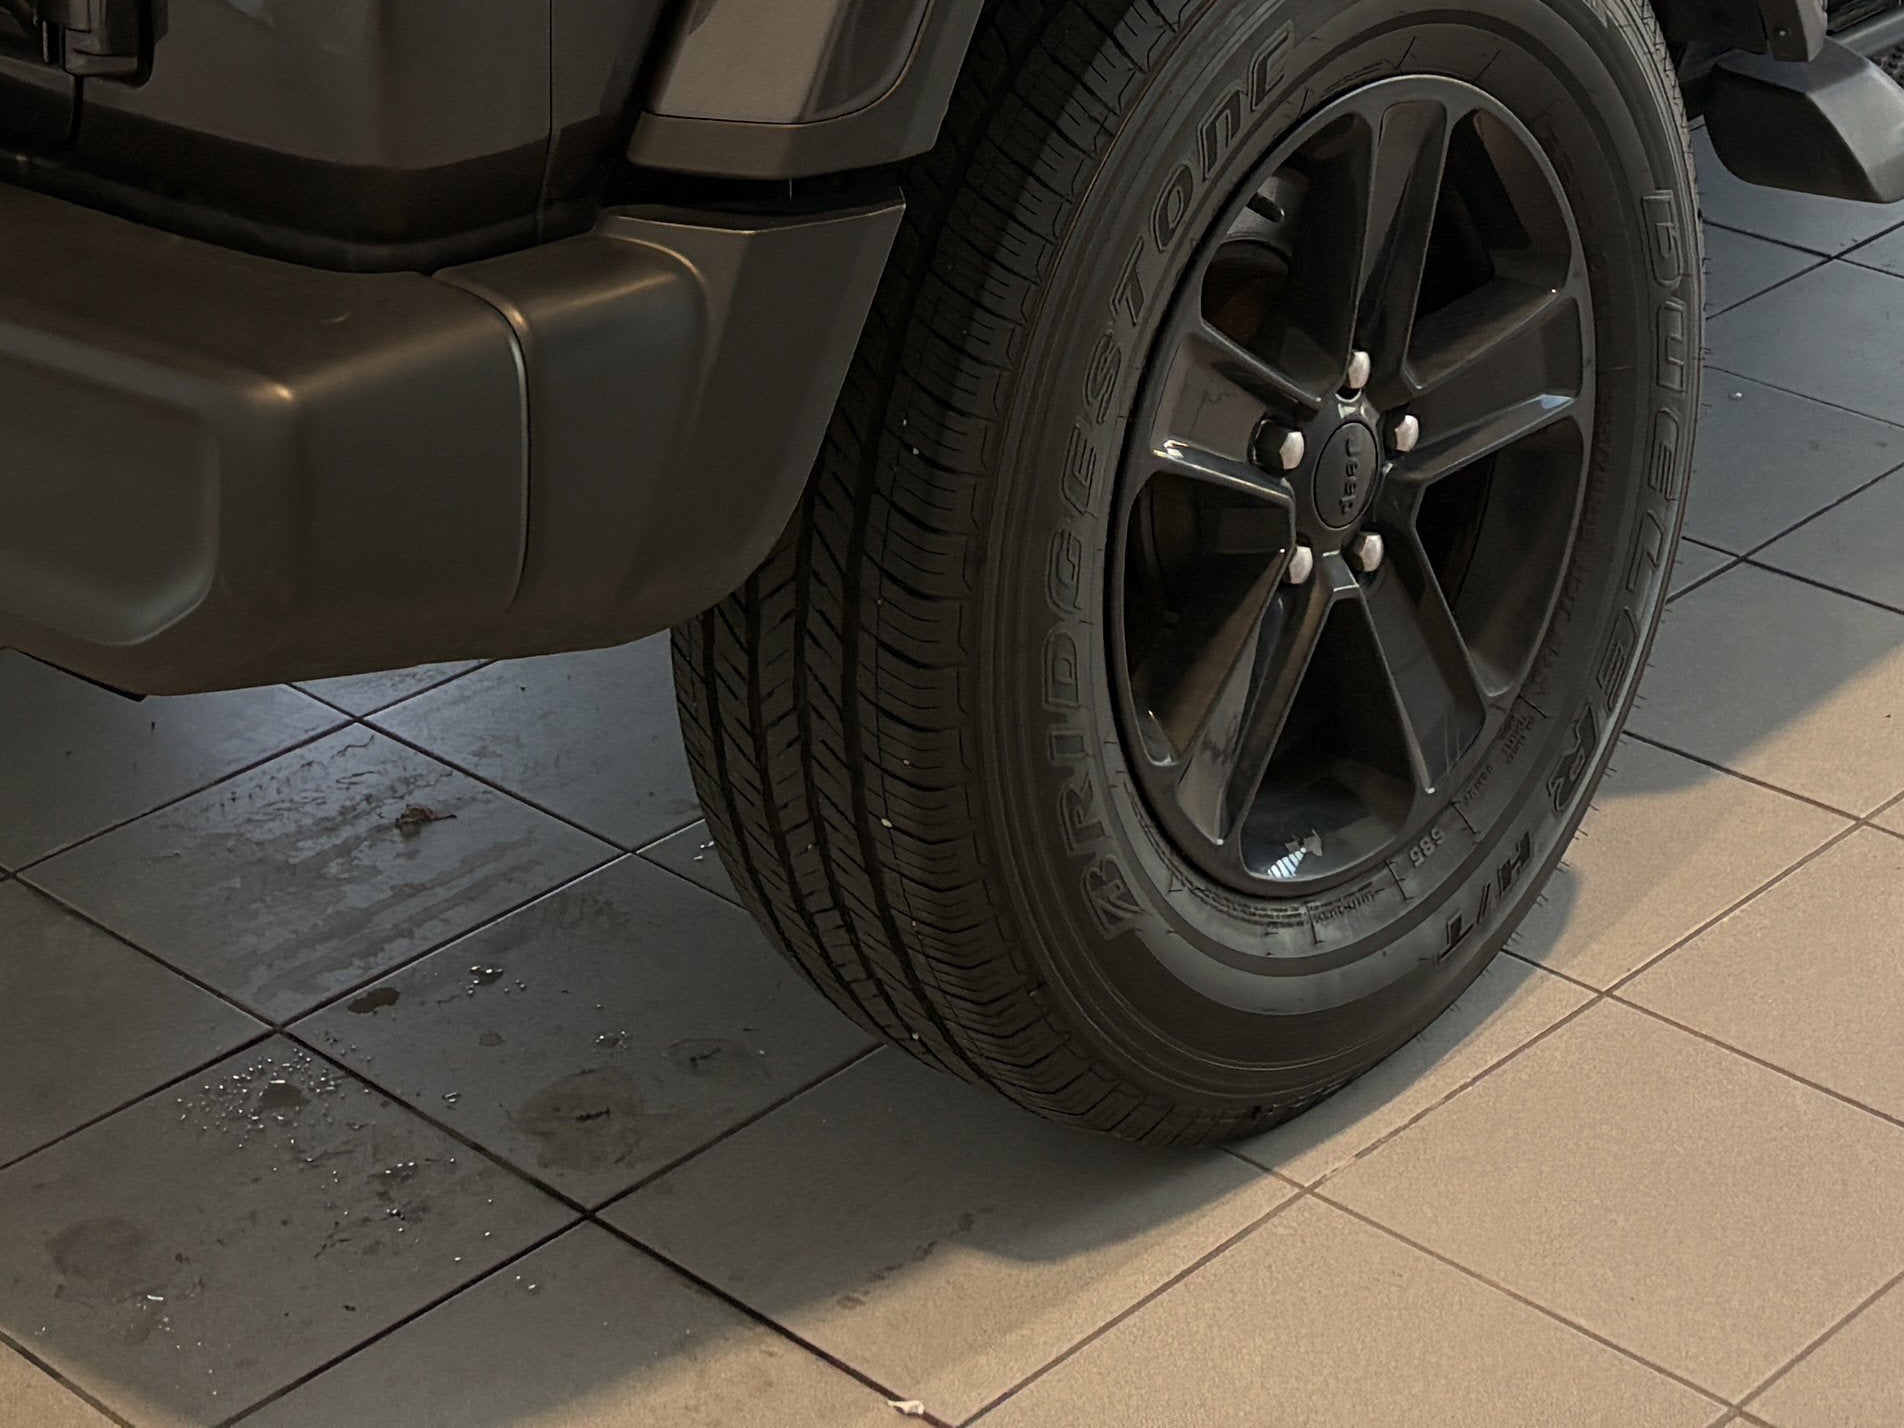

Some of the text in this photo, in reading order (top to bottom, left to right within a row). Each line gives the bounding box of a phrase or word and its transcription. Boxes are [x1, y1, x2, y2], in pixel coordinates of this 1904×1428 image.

[1040, 18, 1296, 941] BRIDGESTONE
[1545, 188, 1685, 815] DUELER
[1437, 829, 1534, 964] H/T
